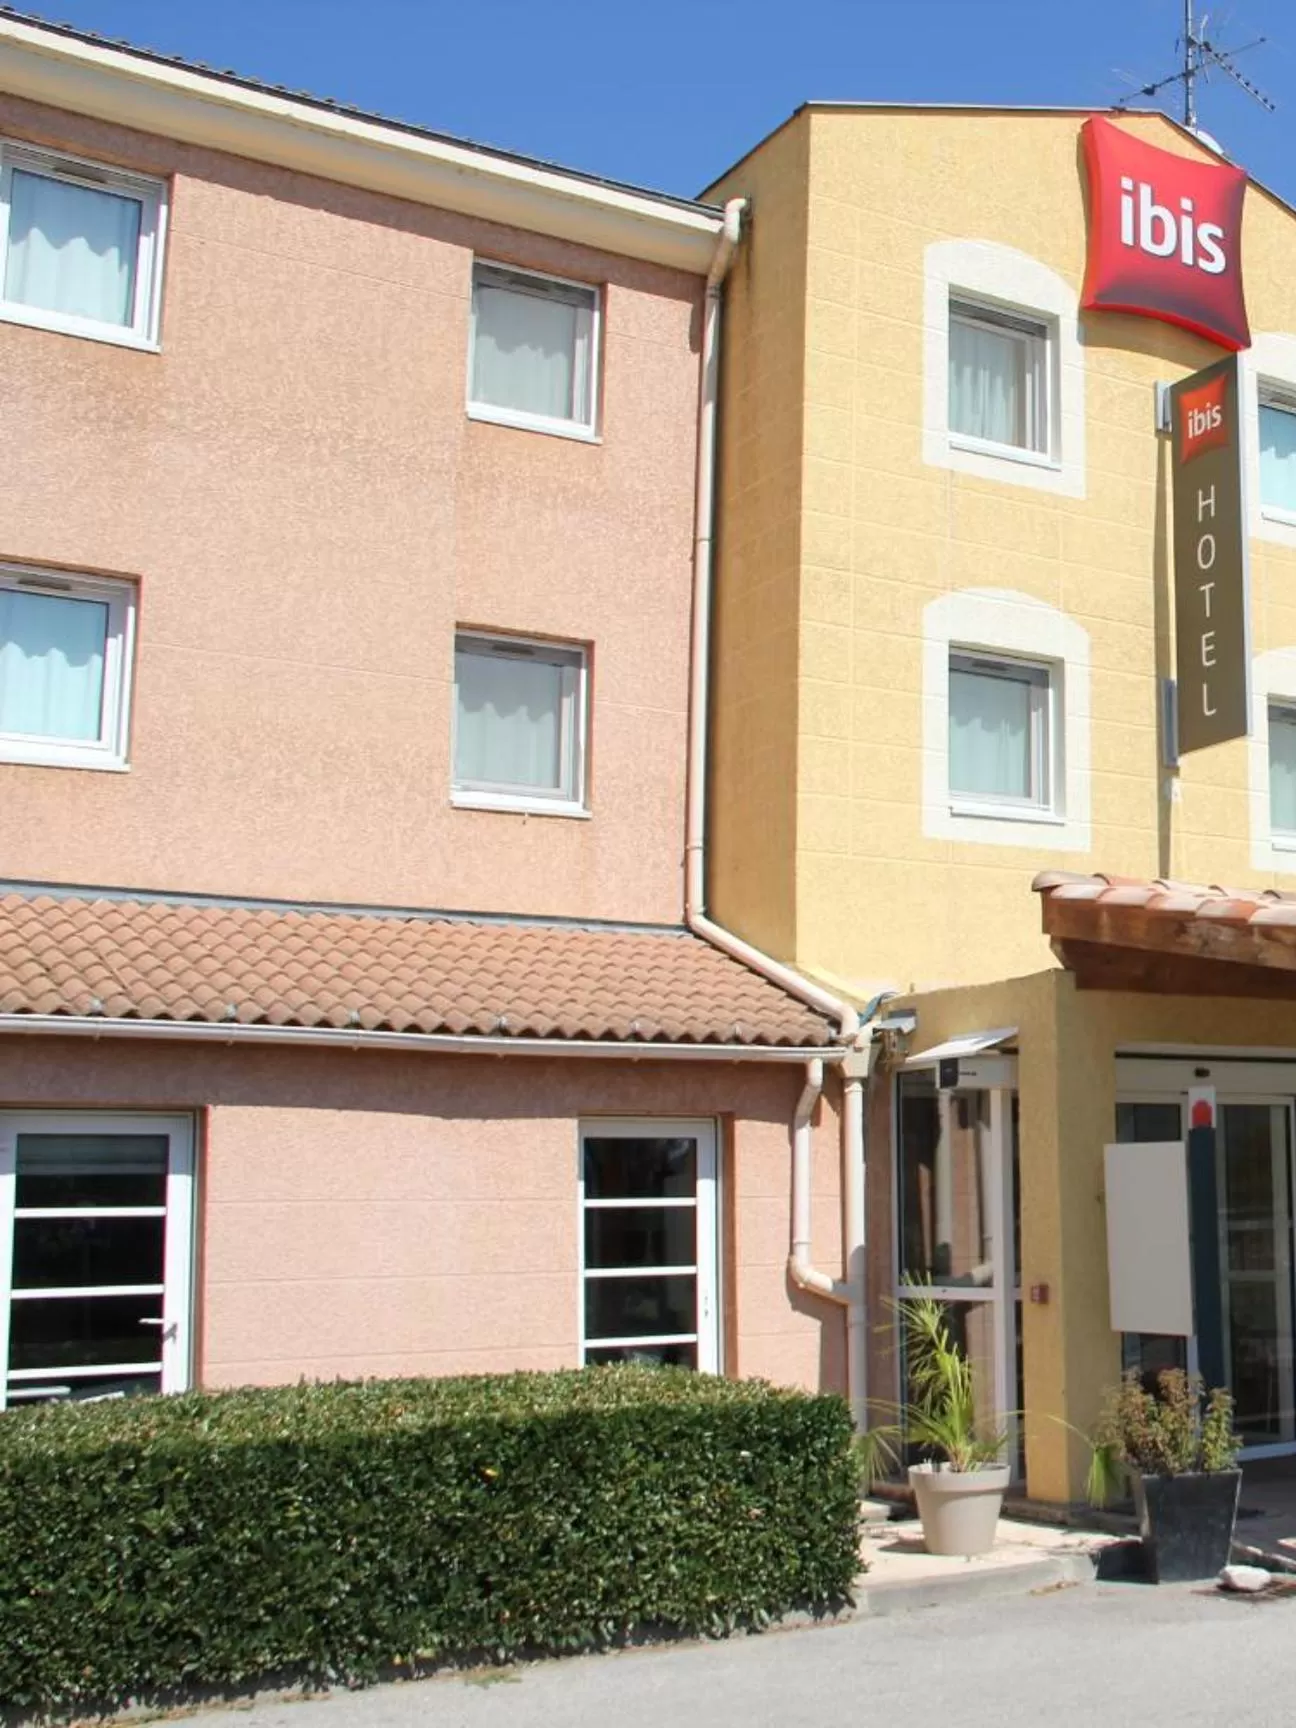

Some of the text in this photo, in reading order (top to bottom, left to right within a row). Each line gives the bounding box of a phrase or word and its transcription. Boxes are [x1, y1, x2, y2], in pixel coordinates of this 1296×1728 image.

[1119, 177, 1227, 274] ibis
[1187, 401, 1222, 439] ibis
[1196, 484, 1216, 717] HOTEL
